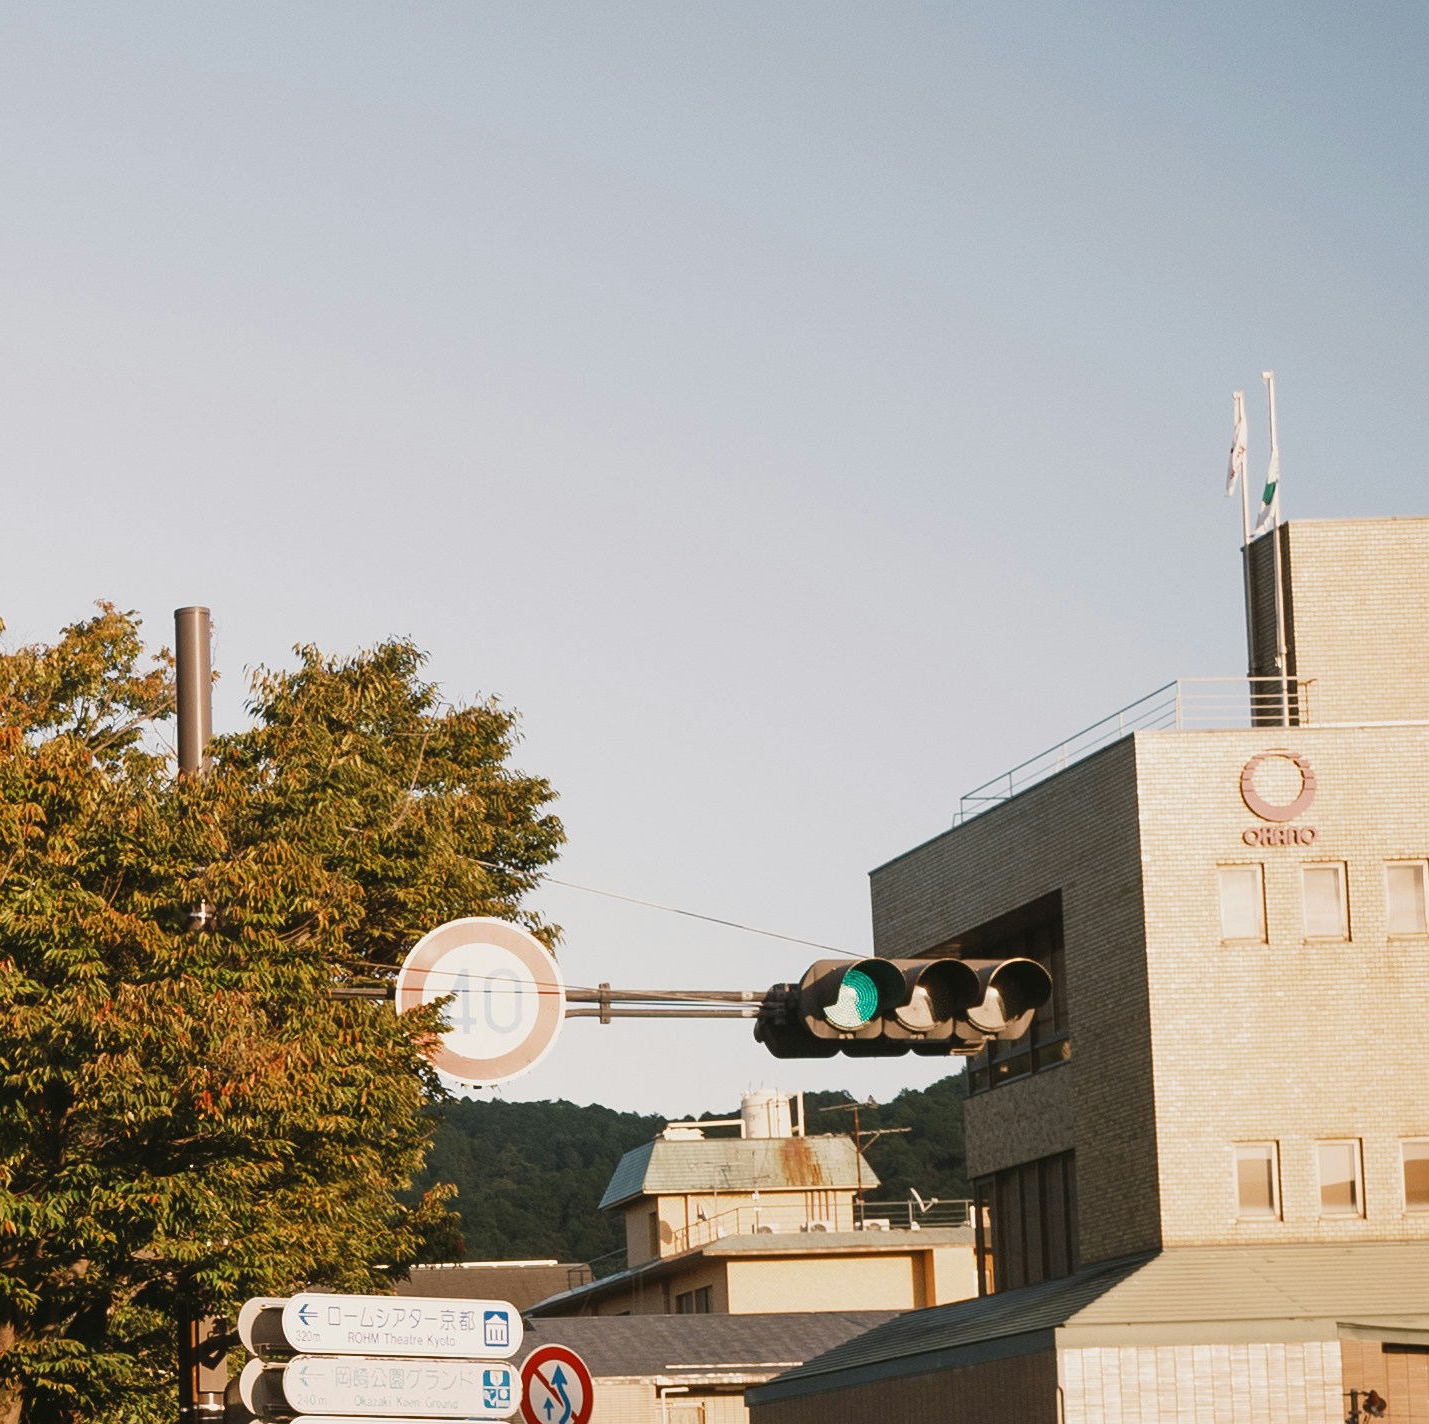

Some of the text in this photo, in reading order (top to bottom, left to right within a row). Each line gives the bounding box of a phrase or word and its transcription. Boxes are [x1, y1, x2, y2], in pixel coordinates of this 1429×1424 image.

[442, 968, 523, 1035] 40
[327, 1306, 476, 1332] ロームシアター京都
[295, 1330, 456, 1348] 320m ROHM Theatre Kyoto
[334, 1366, 474, 1390] 岡崎公園グランド
[355, 1395, 391, 1408] Okazaki
[396, 1396, 421, 1408] Koen
[425, 1397, 459, 1409] Ground
